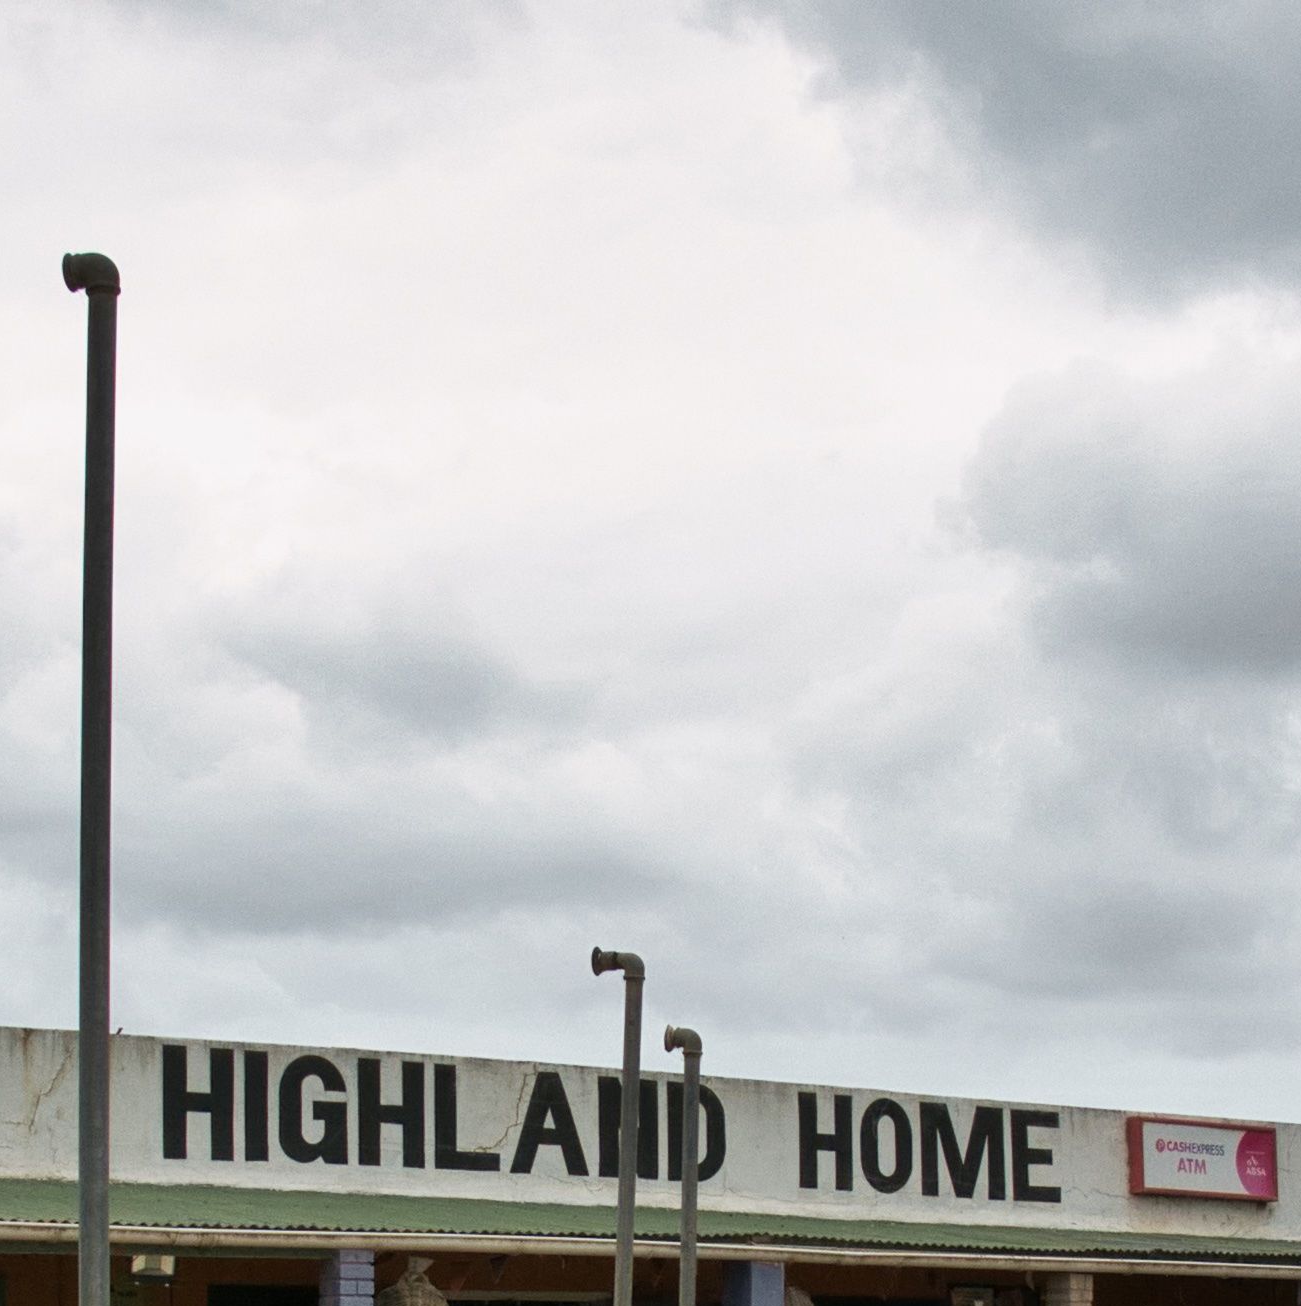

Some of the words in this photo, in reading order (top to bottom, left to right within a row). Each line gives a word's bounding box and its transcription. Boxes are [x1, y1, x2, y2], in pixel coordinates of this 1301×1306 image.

[163, 1044, 727, 1183] HIGHLAND
[798, 1091, 1062, 1204] HOME
[1177, 1158, 1207, 1174] ATM
